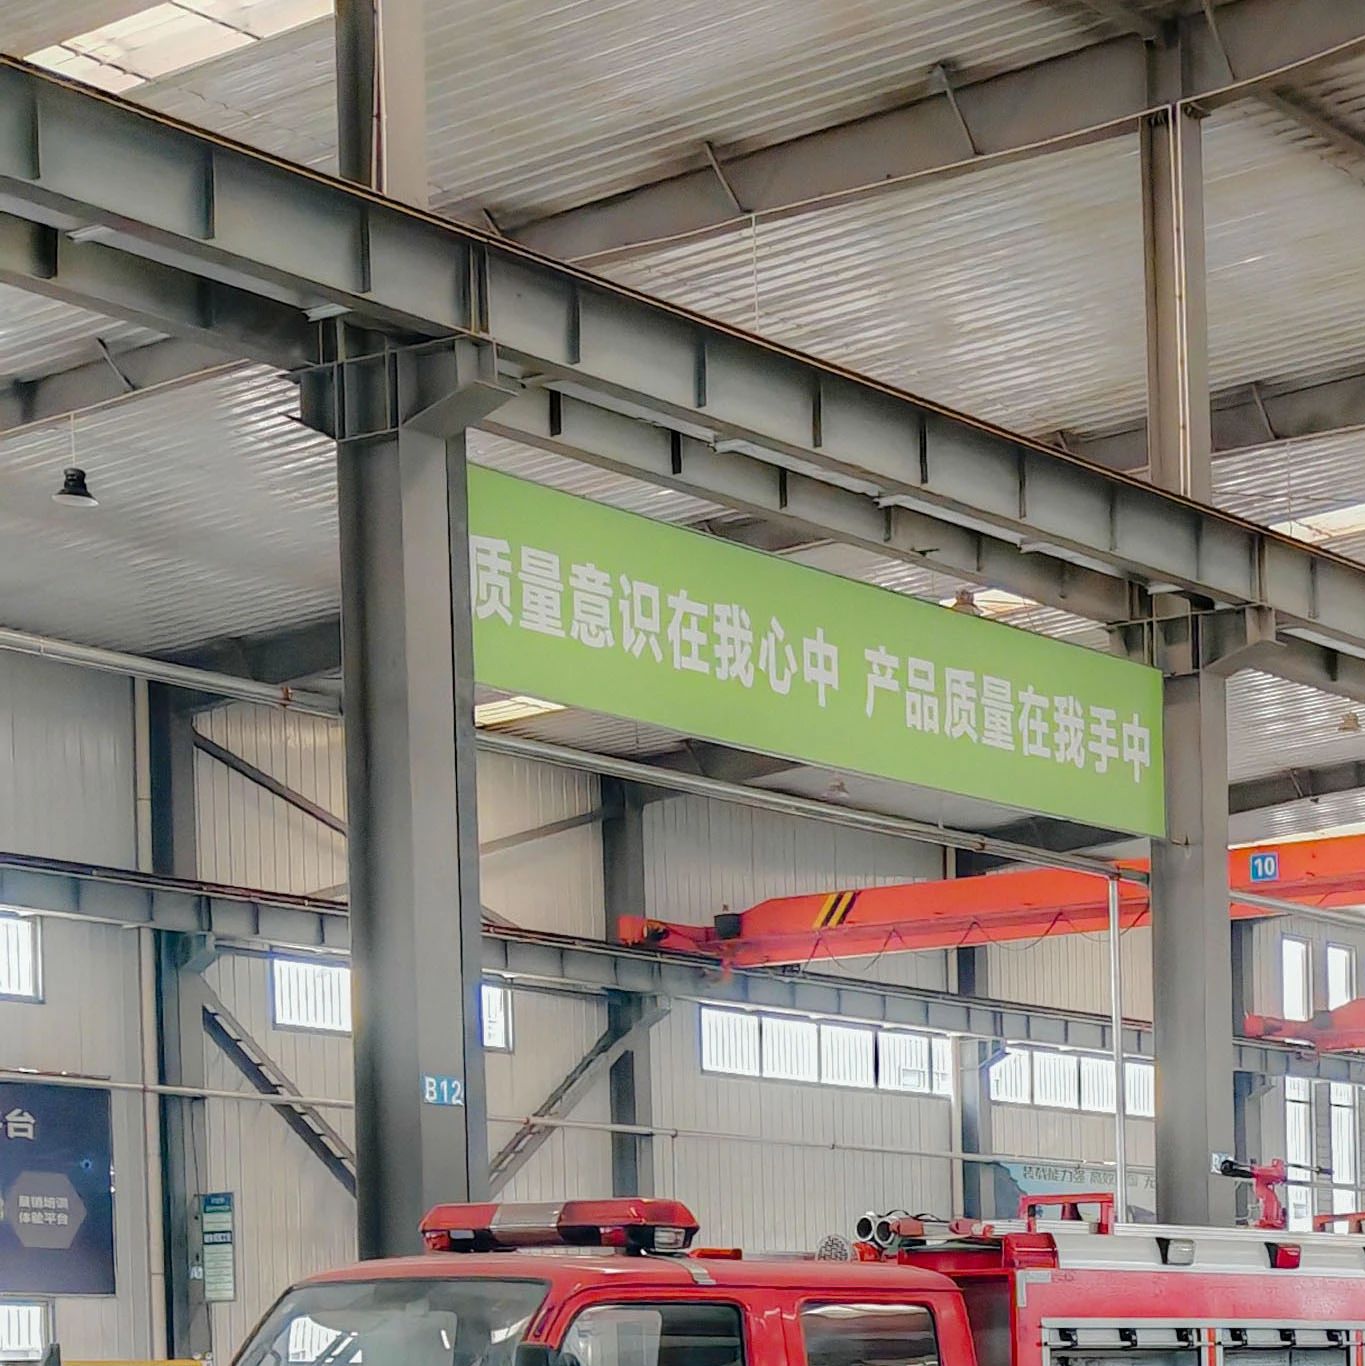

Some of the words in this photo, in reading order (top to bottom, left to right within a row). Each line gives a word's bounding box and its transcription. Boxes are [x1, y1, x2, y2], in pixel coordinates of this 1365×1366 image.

[469, 534, 840, 707] 质量意识在我心中
[864, 645, 1151, 783] 产品质量在我手中
[1254, 857, 1275, 877] 10
[424, 1076, 464, 1106] B12
[0, 1107, 36, 1140] 台
